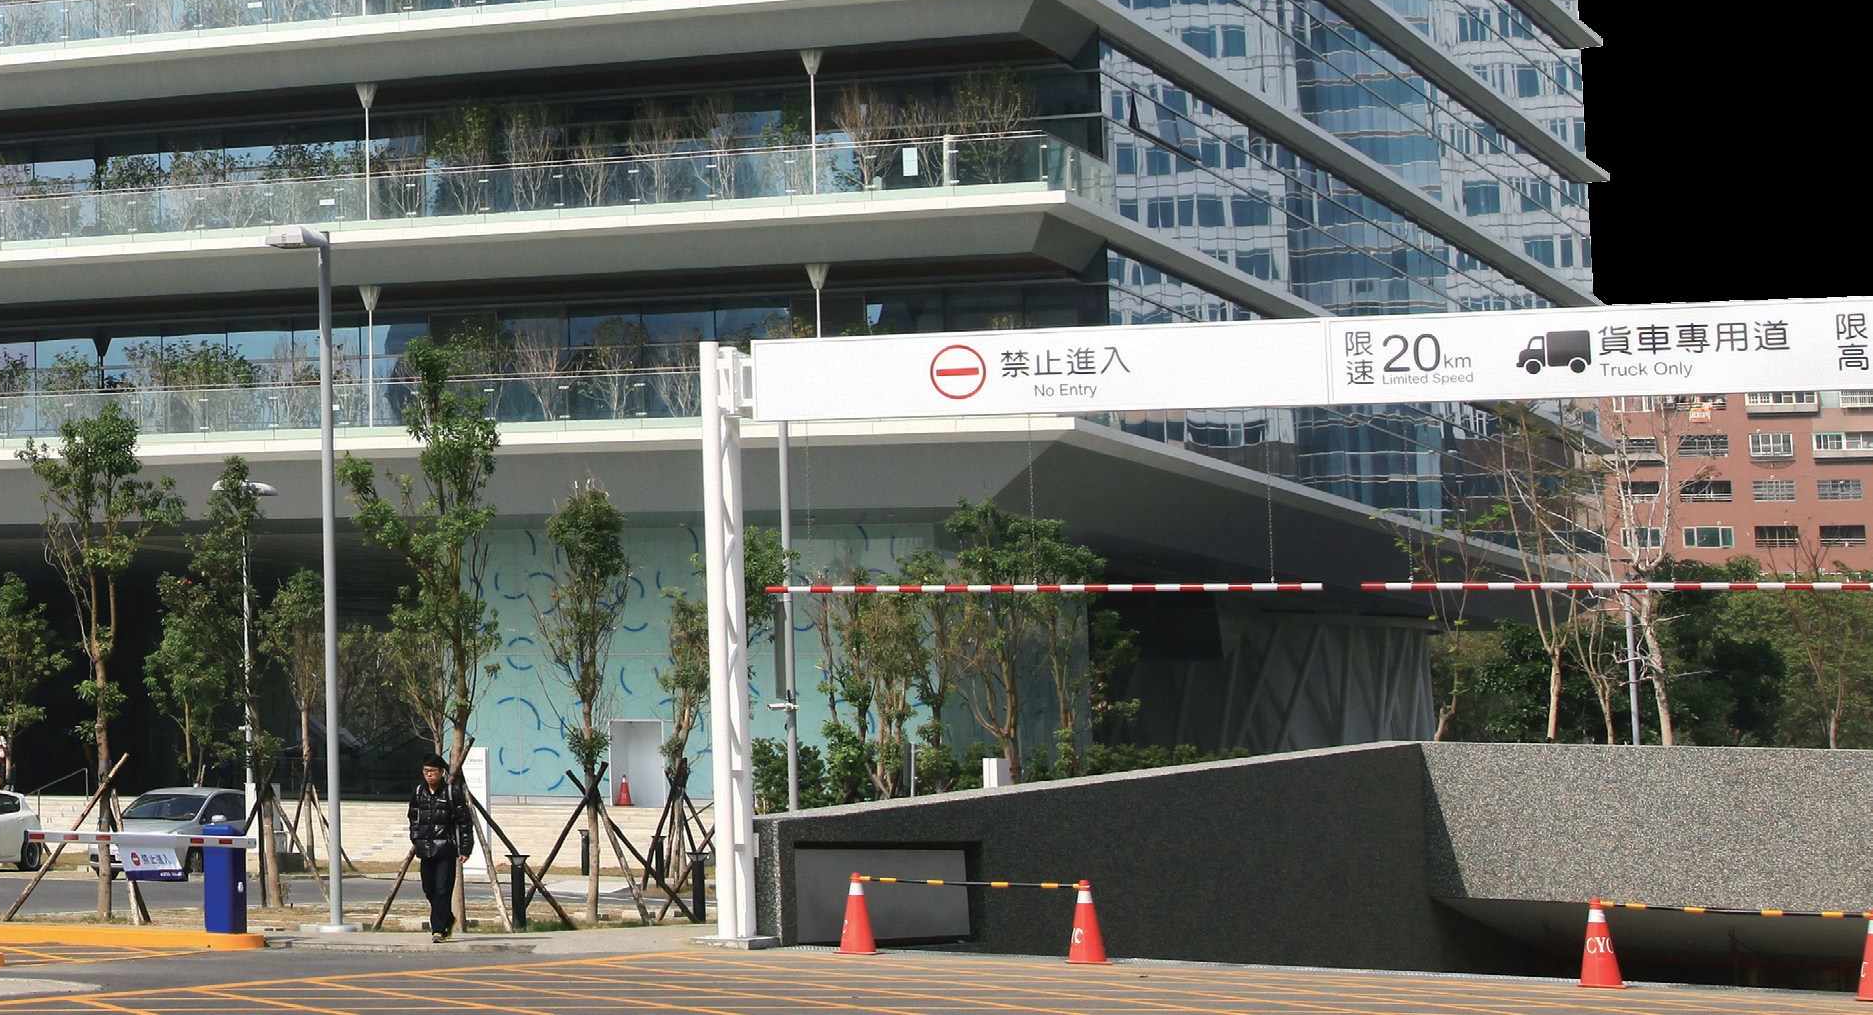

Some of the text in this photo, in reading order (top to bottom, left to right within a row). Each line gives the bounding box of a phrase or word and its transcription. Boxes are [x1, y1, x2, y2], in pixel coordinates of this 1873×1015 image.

[1598, 320, 1790, 355] 貨車專用道
[1836, 313, 1869, 371] 限高
[1000, 347, 1130, 377] 禁止進入
[1345, 331, 1374, 385] 限速
[1599, 361, 1693, 378] Truck Only
[1034, 384, 1097, 398] No Entry
[1382, 372, 1474, 386] Limited Speed
